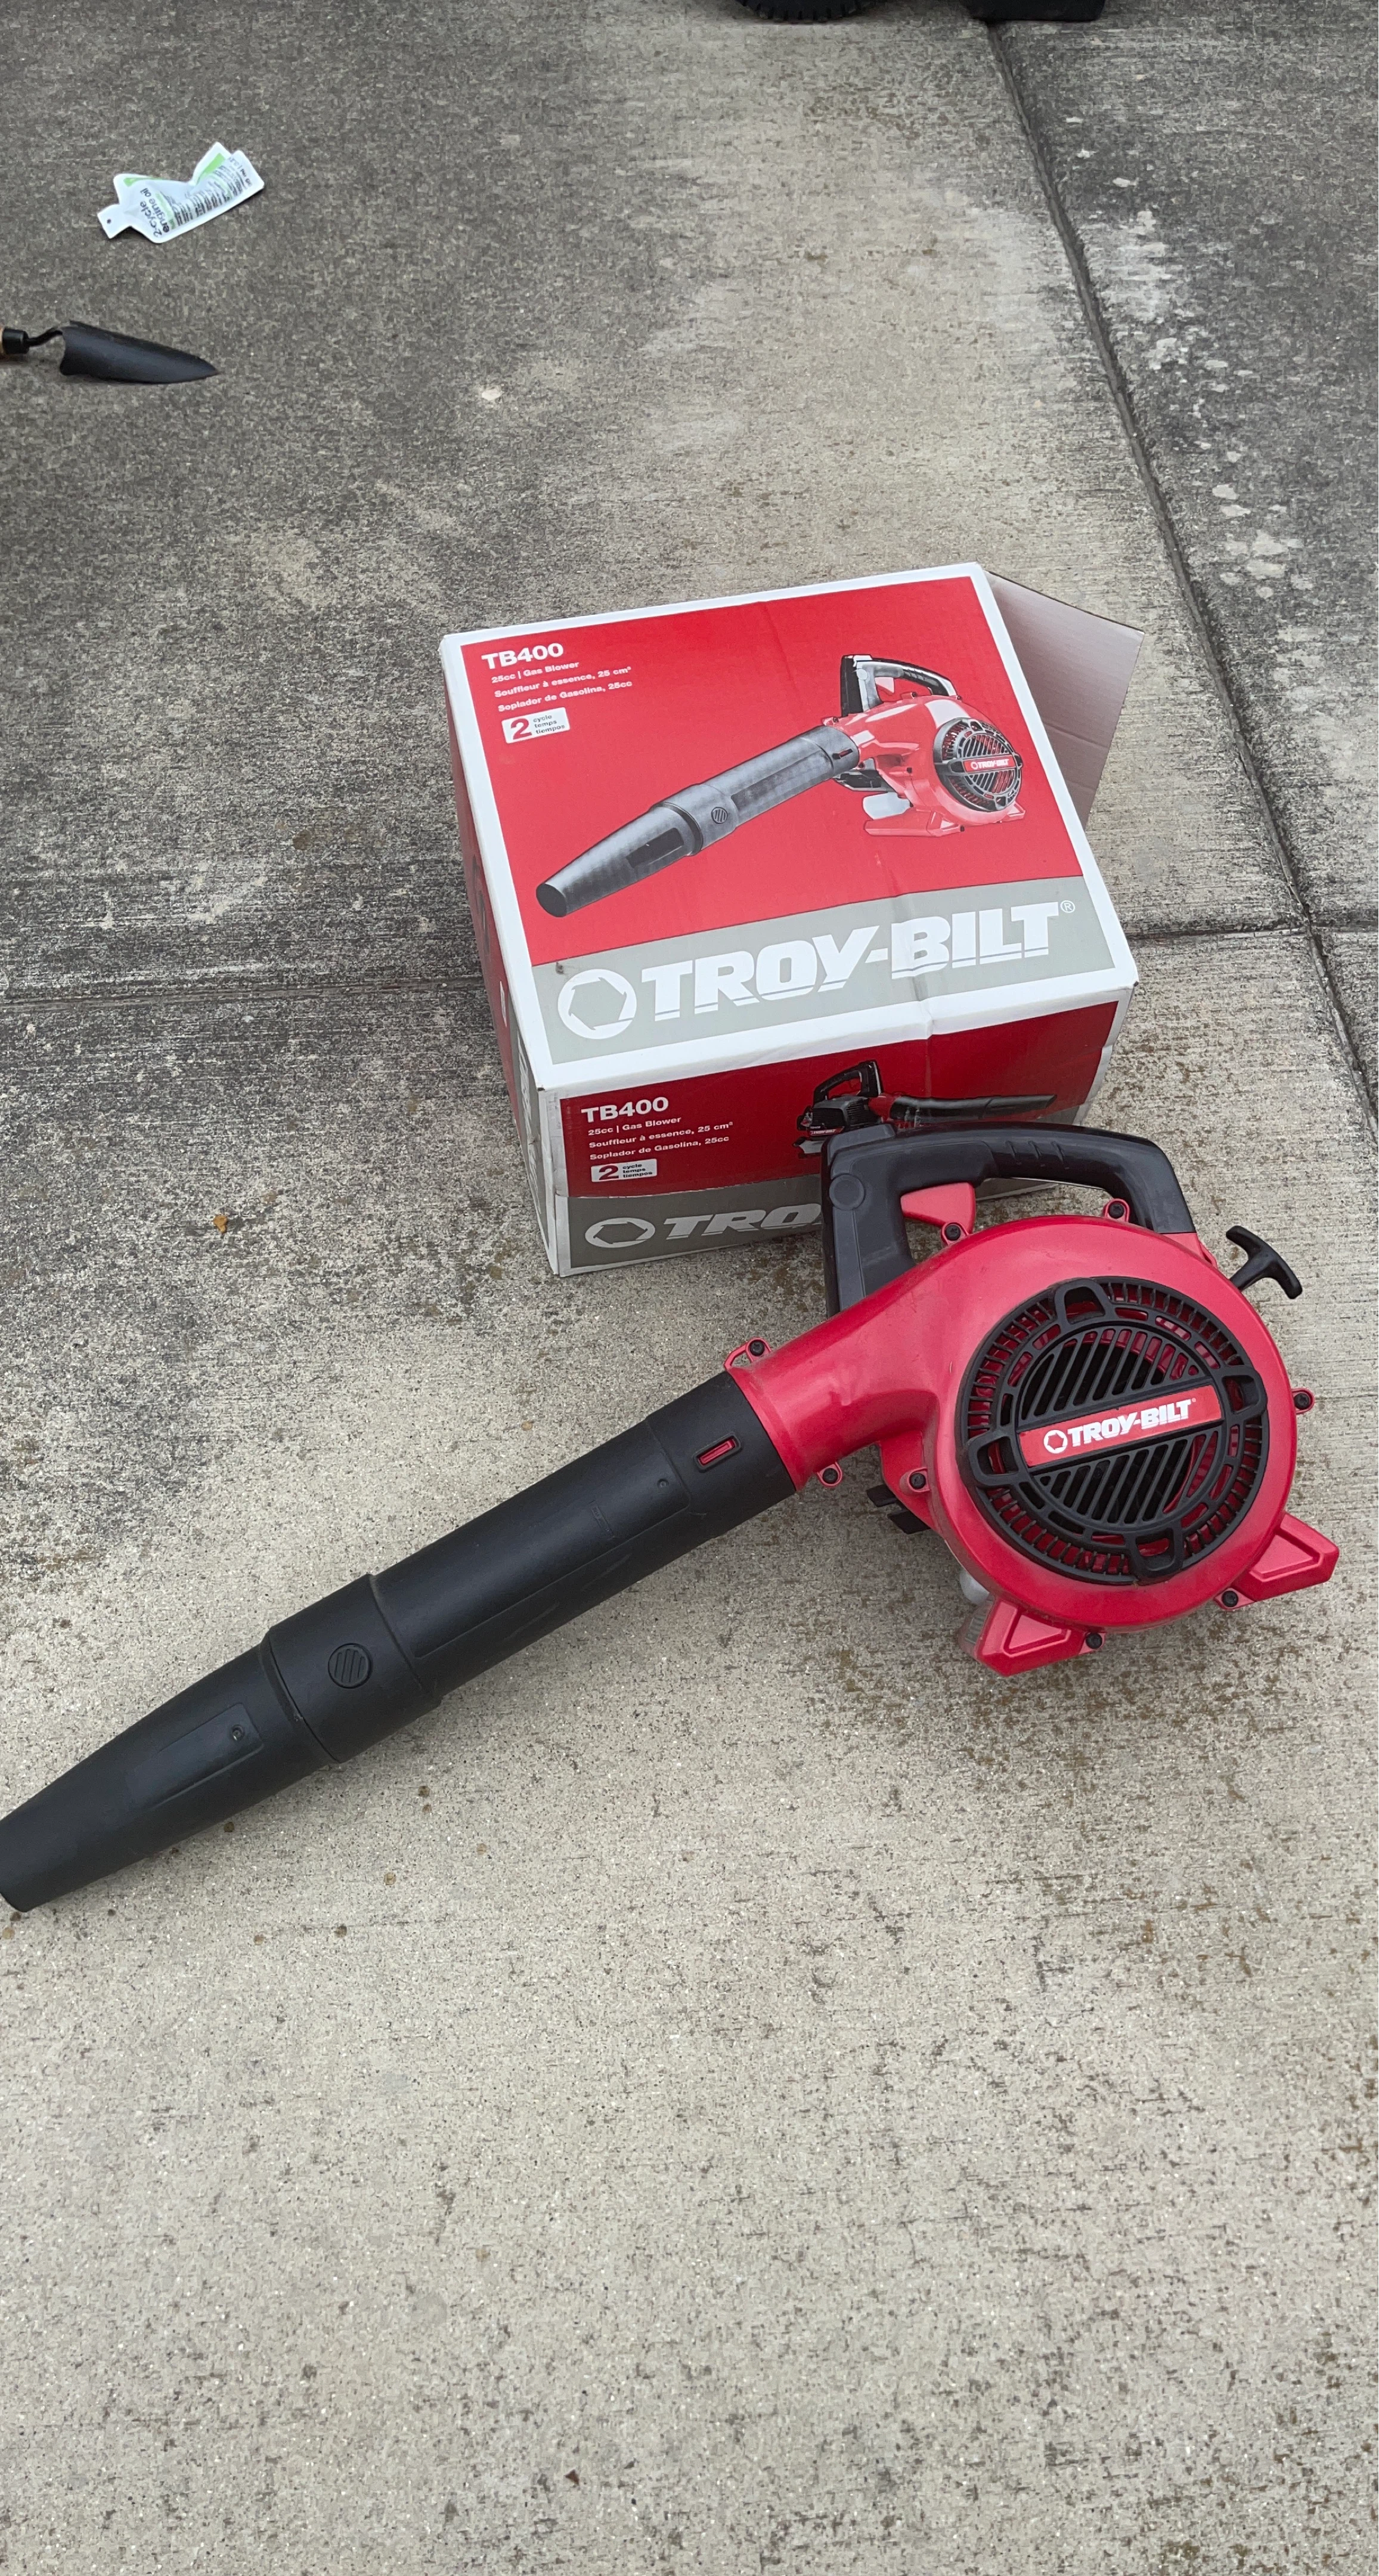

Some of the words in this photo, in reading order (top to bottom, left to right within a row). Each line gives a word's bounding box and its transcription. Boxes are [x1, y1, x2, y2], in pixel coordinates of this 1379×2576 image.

[140, 188, 151, 197] oil
[140, 201, 162, 237] 2-cycle
[149, 198, 169, 233] engine
[481, 643, 564, 670] TB400
[491, 673, 516, 683] 25cc
[523, 668, 543, 677] Gas
[545, 662, 580, 673] Blower
[494, 683, 540, 698] Souffleur
[551, 673, 596, 686] essence,
[597, 670, 610, 678] 25
[498, 698, 542, 712] Soplador
[559, 686, 606, 699] Gasolina,
[608, 681, 633, 690] 25cc
[510, 718, 532, 740] 2
[535, 720, 557, 728] temps
[535, 724, 565, 735] tiempos
[641, 900, 1059, 1021] TROY-BILT
[581, 1097, 669, 1123] TB400
[588, 1127, 613, 1136] 25cc
[622, 1123, 643, 1131] Gas
[645, 1117, 681, 1128] Blower
[589, 1135, 637, 1148] Souffleur
[649, 1128, 695, 1140] essence,
[698, 1125, 710, 1133] 25
[590, 1148, 636, 1160] Soplador
[654, 1140, 702, 1152] Gasolina,
[705, 1136, 729, 1144] 25cc
[599, 1165, 619, 1180] 2
[664, 1203, 822, 1240] TRO
[1067, 1399, 1191, 1447] TROY-BILT
